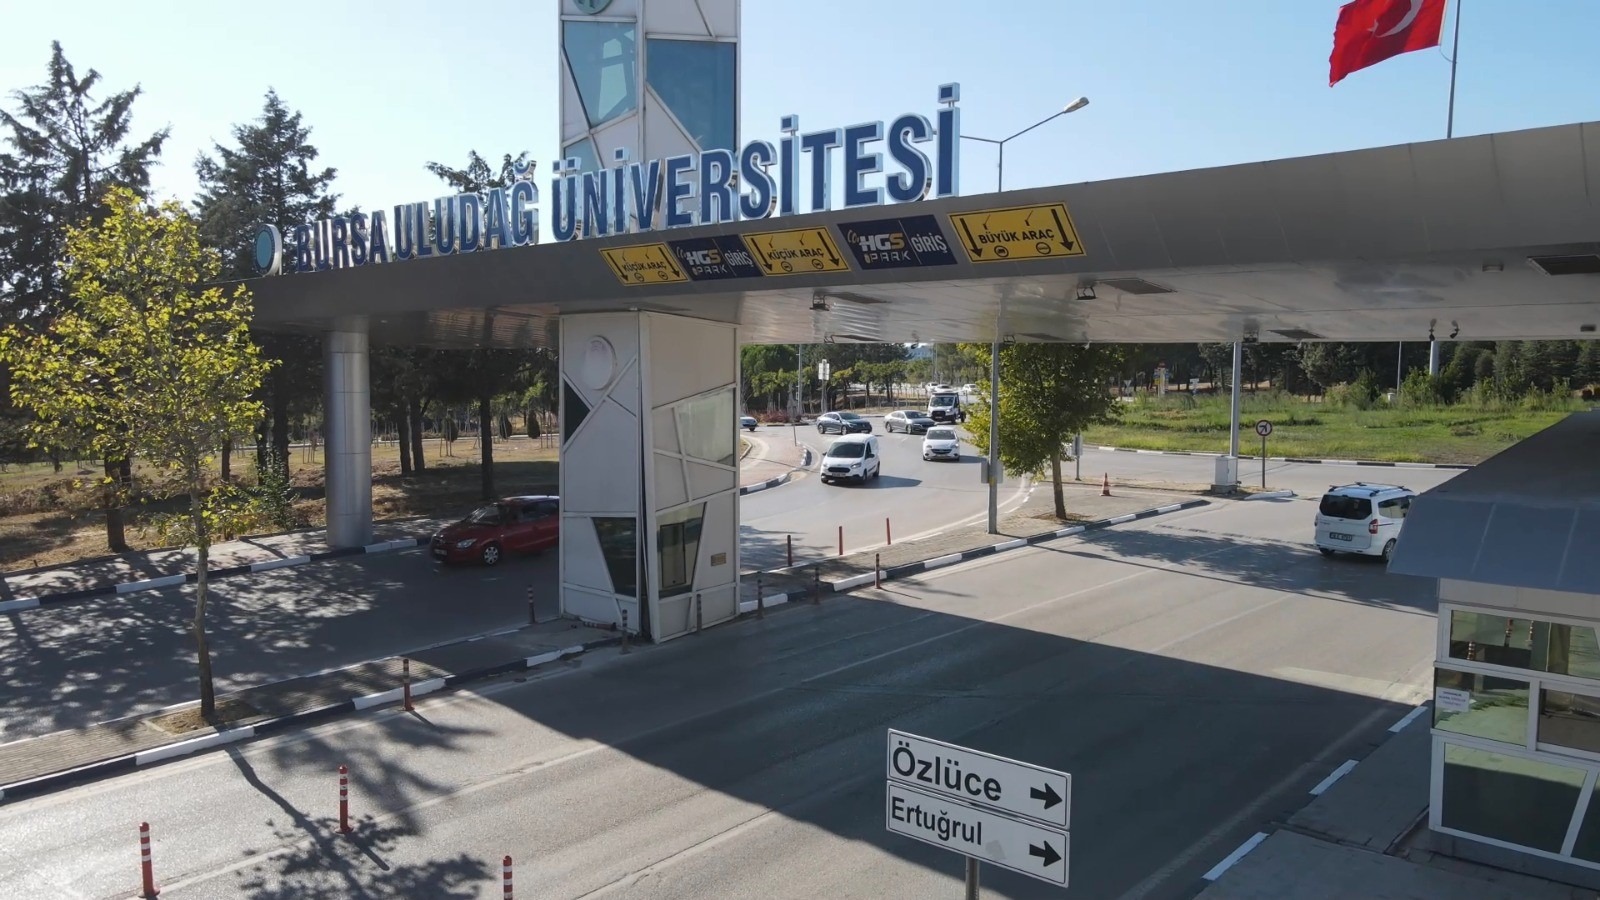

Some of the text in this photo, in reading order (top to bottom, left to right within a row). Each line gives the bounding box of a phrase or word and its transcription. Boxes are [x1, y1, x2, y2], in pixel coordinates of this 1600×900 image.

[297, 210, 390, 272] BURSA
[394, 159, 538, 260] ULUDAĞ
[551, 83, 960, 242] ÜNİVERSİTESİ
[859, 233, 947, 253] HGS GİRİŞ
[978, 228, 1055, 244] BÜYÜK ARAÇ
[686, 249, 754, 268] HGS GİRİŞ
[767, 247, 825, 260] KÜÇÜK ARAÇ
[870, 250, 912, 263] PARK
[622, 261, 667, 273] KÜÇÜK ARAÇ
[893, 741, 1002, 802] Özlüce
[891, 796, 982, 846] Ertuğrul
